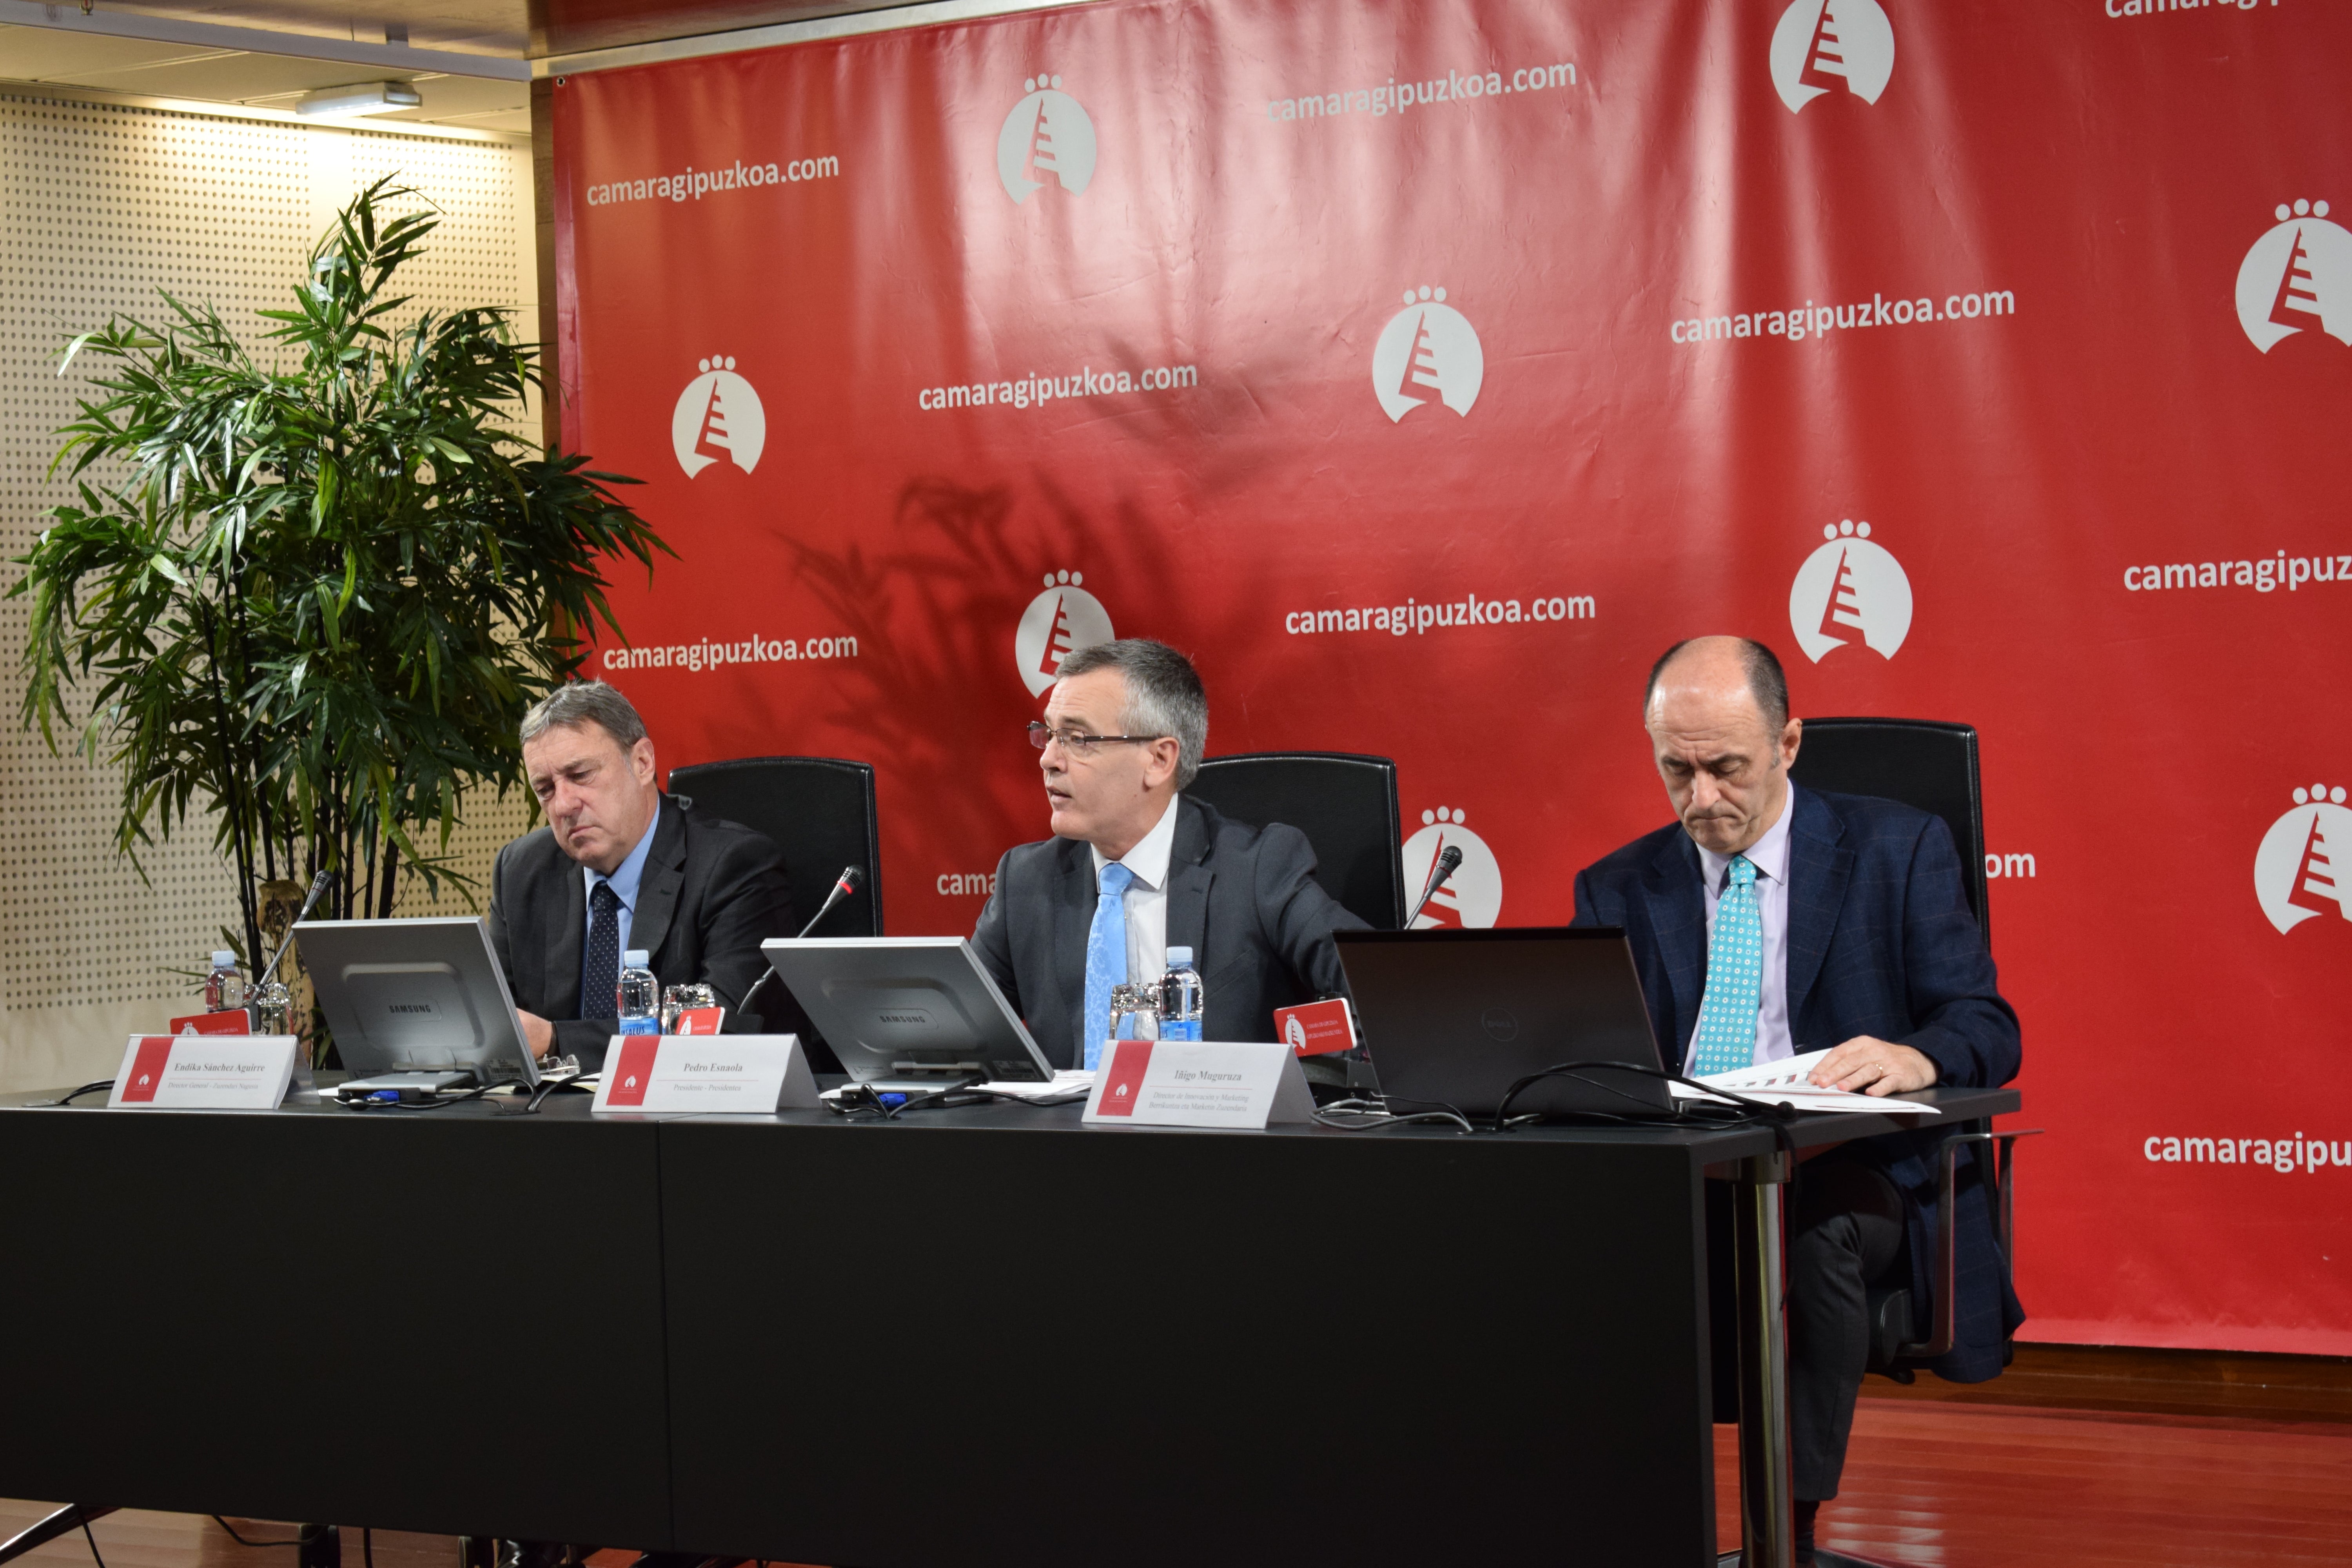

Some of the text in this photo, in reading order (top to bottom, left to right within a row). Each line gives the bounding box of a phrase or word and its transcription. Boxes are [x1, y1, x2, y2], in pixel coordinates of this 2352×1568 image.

[1267, 62, 1576, 122] camaragipuzkoa.com
[587, 156, 838, 205] camaragipuzkoa.com
[1671, 290, 2014, 343] camaragipuzkoa.com
[919, 365, 1197, 410] camaragipuzkoa.com
[2124, 550, 2352, 592] camaragipuz
[1286, 593, 1595, 636] camaragipuzkoa.com
[603, 634, 858, 671] camaragipuzkoa.com
[621, 1025, 645, 1035] INSALUS
[174, 1063, 265, 1074] Endika Sánchez Aguirre
[684, 1063, 743, 1072] Pedro Esnaola
[1174, 1070, 1242, 1082] Iñigo Muguruza
[1221, 1094, 1249, 1103] Marketing
[2144, 1131, 2352, 1173] camaragipu
